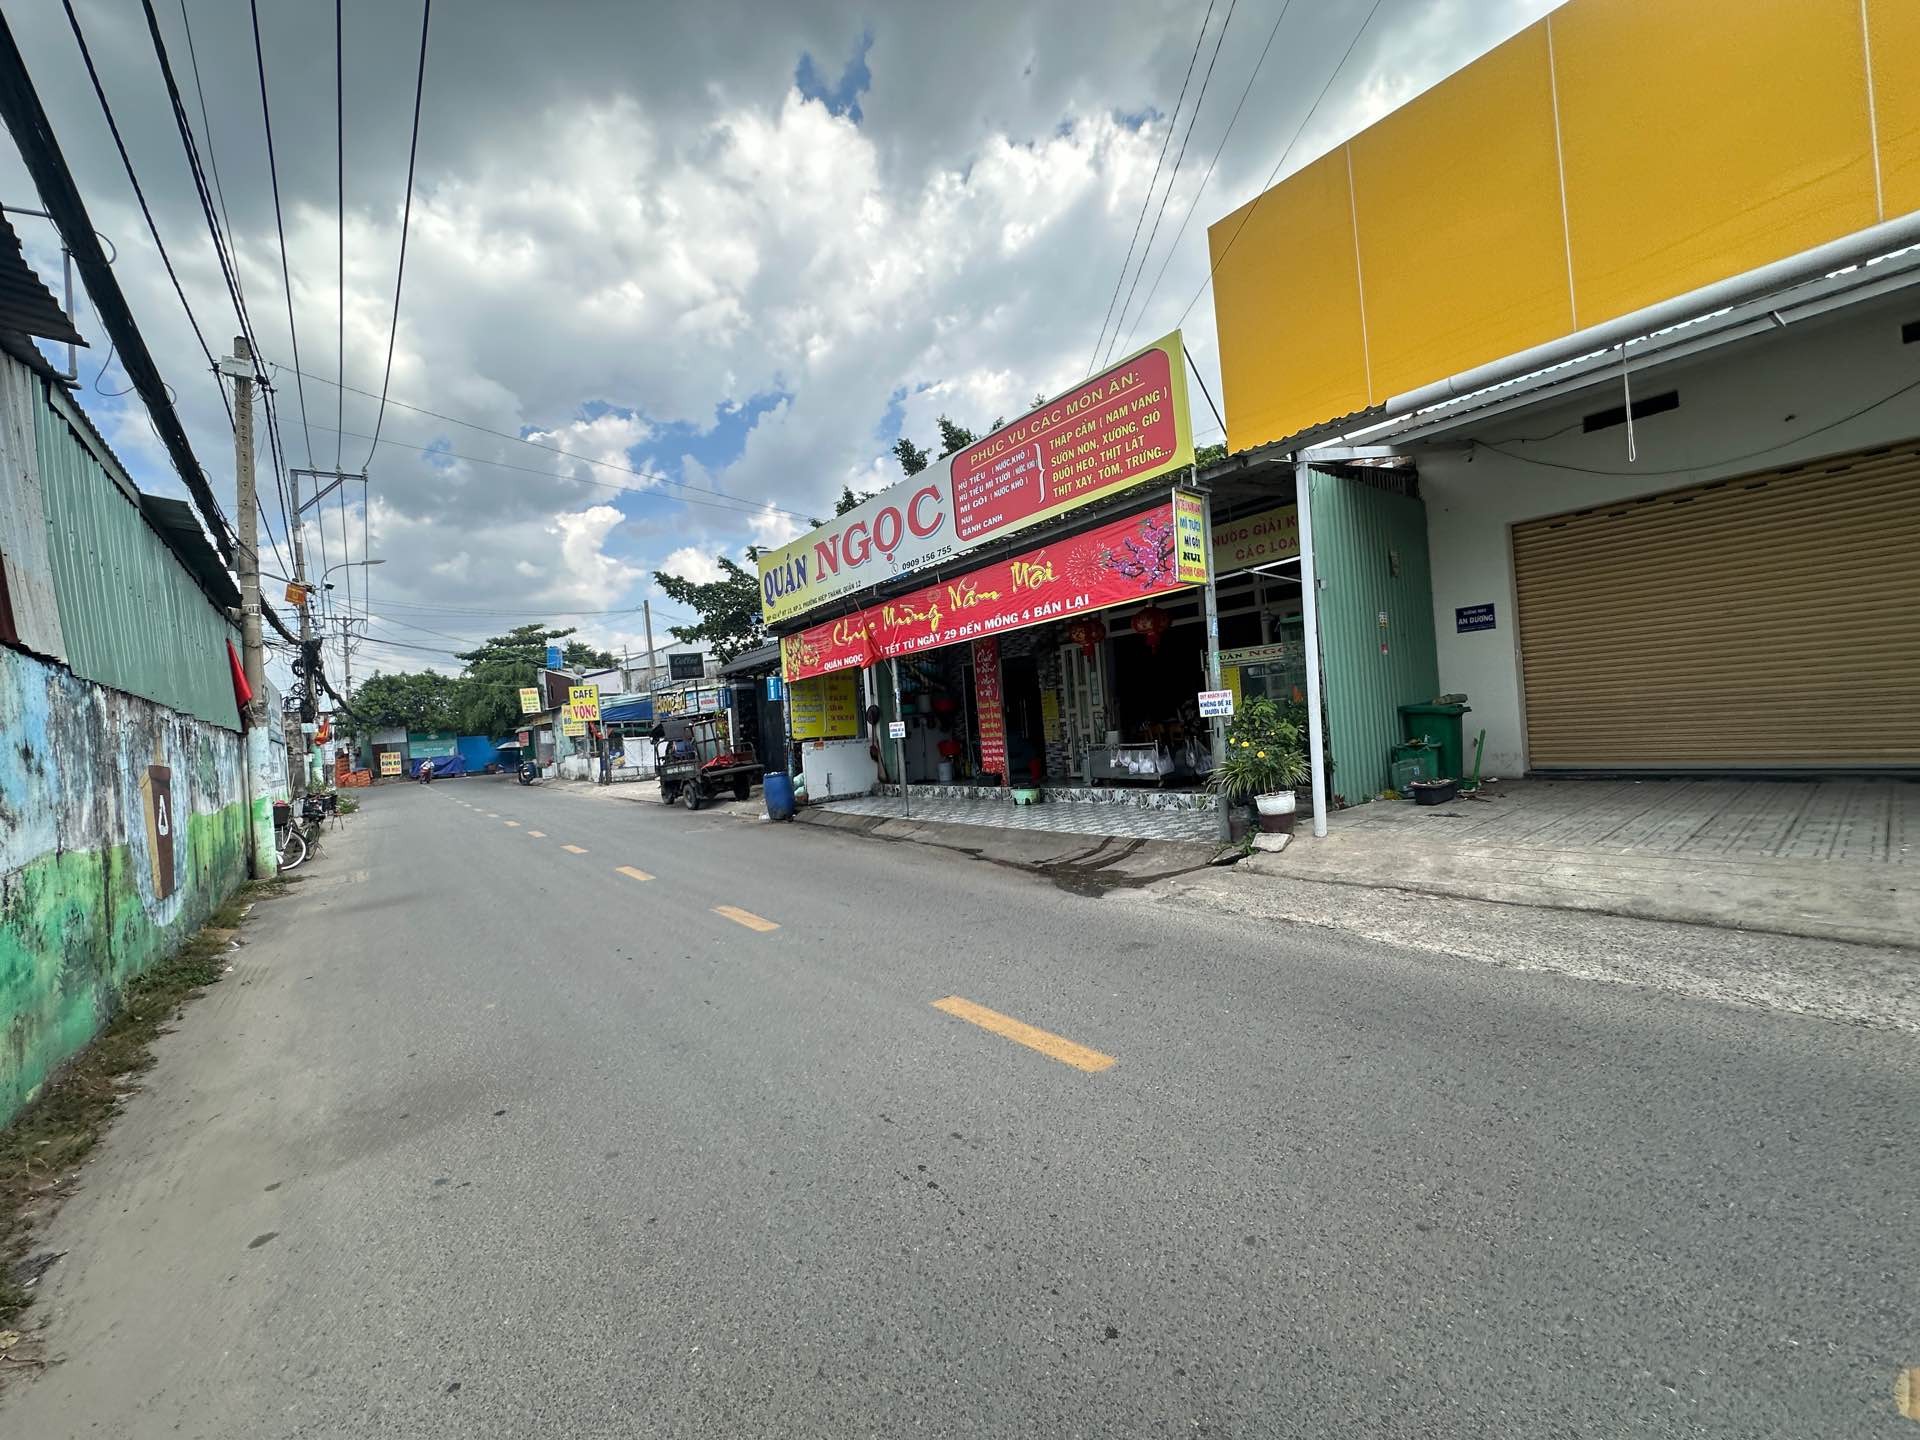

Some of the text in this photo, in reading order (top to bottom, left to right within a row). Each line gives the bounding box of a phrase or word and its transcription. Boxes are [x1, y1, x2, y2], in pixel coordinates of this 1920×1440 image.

[1030, 409, 1063, 434] CÁC
[1065, 387, 1104, 416] MÓN
[1130, 389, 1161, 413] VANG
[960, 513, 974, 526] NUI
[982, 512, 1004, 529] CANH
[763, 484, 945, 608] QUÁN NGỌC
[1182, 550, 1202, 564] NUI
[1235, 542, 1266, 562] CÁC
[901, 543, 953, 572] 0909 156 755
[881, 602, 943, 633] Mừng
[946, 576, 1002, 612] Năm
[1010, 549, 1060, 594] Mới
[884, 639, 901, 656] TẾT
[902, 637, 916, 651] TỪ
[916, 631, 942, 647] NGÀY
[943, 627, 958, 640] 29
[959, 618, 982, 637] ĐẾN
[1021, 609, 1031, 620] 4
[1033, 602, 1062, 618] BÁN
[1065, 593, 1090, 610] LẠI
[1219, 652, 1243, 661] UÁN
[573, 688, 594, 700] CAFÉ
